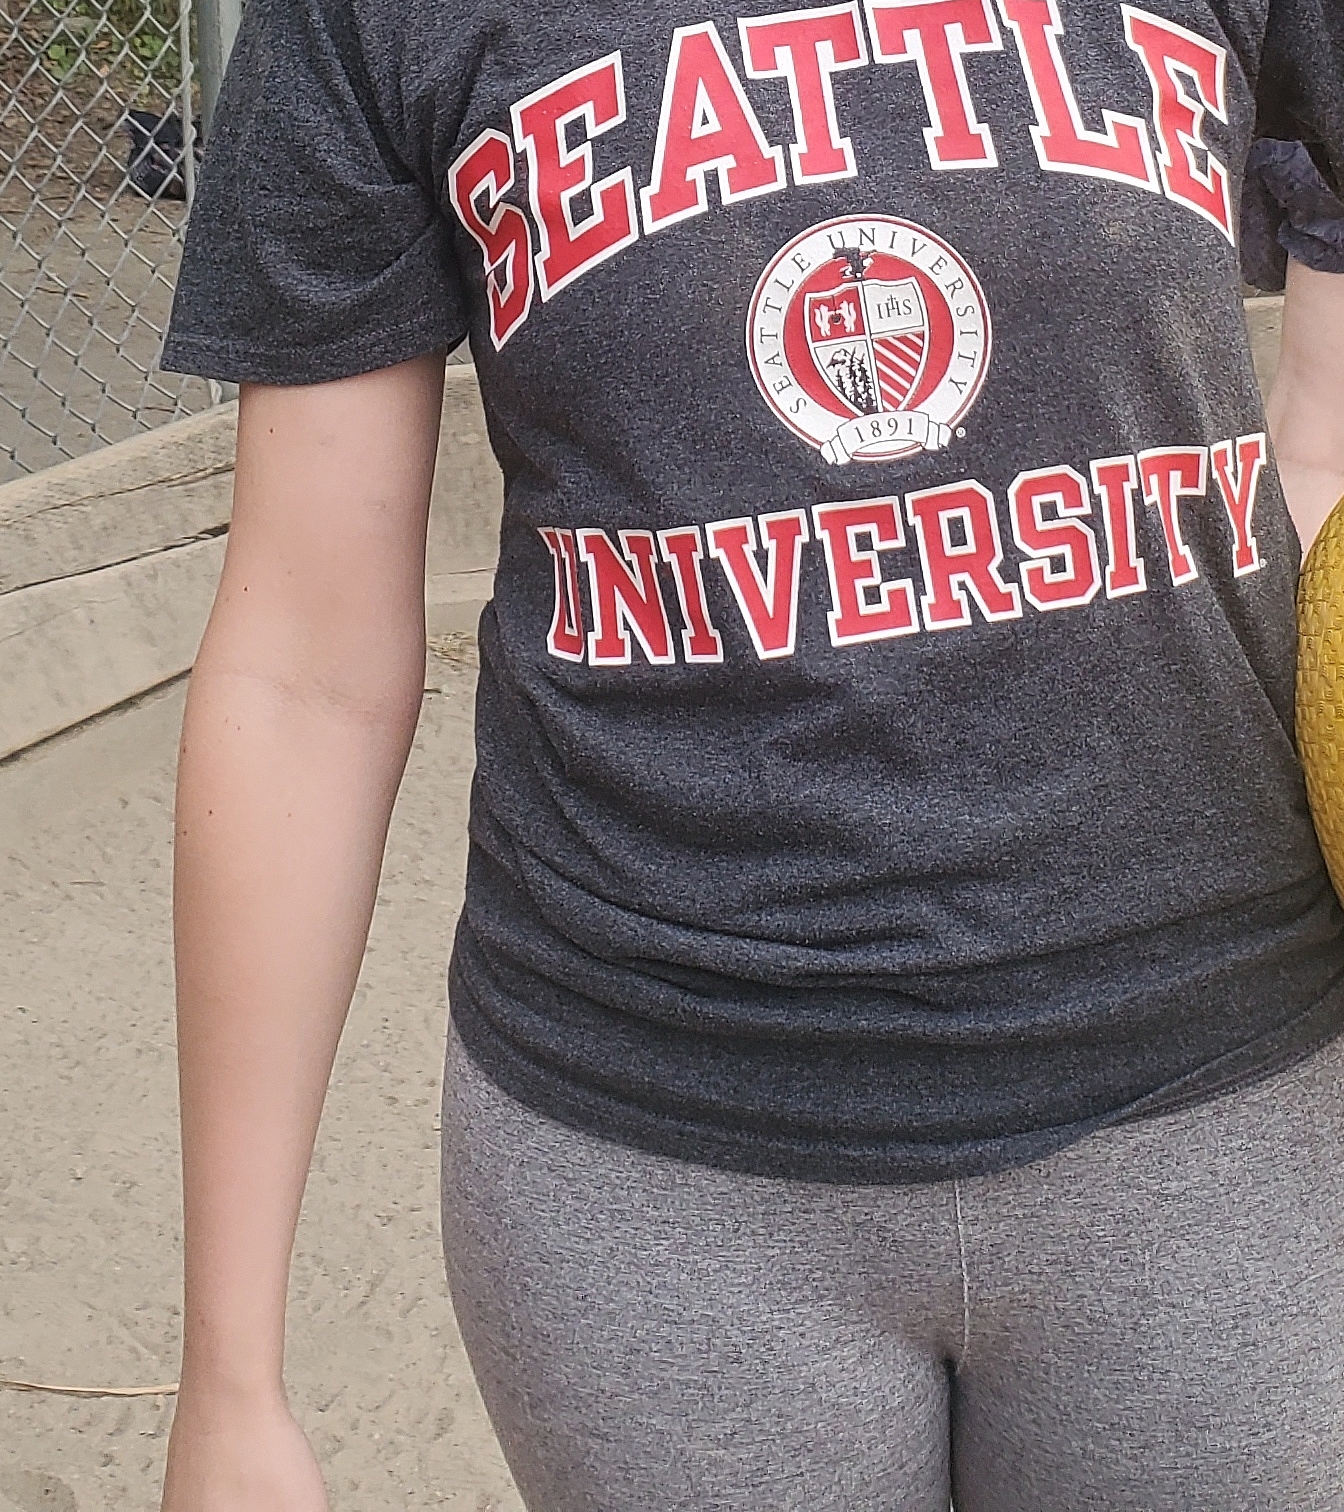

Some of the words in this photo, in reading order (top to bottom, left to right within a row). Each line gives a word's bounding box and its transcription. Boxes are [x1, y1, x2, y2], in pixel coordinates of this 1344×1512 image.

[759, 252, 811, 414] SEATTLE
[827, 227, 979, 395] UNIVERSITY
[855, 417, 915, 443] 1891
[538, 434, 1267, 667] UNIVERSITY
